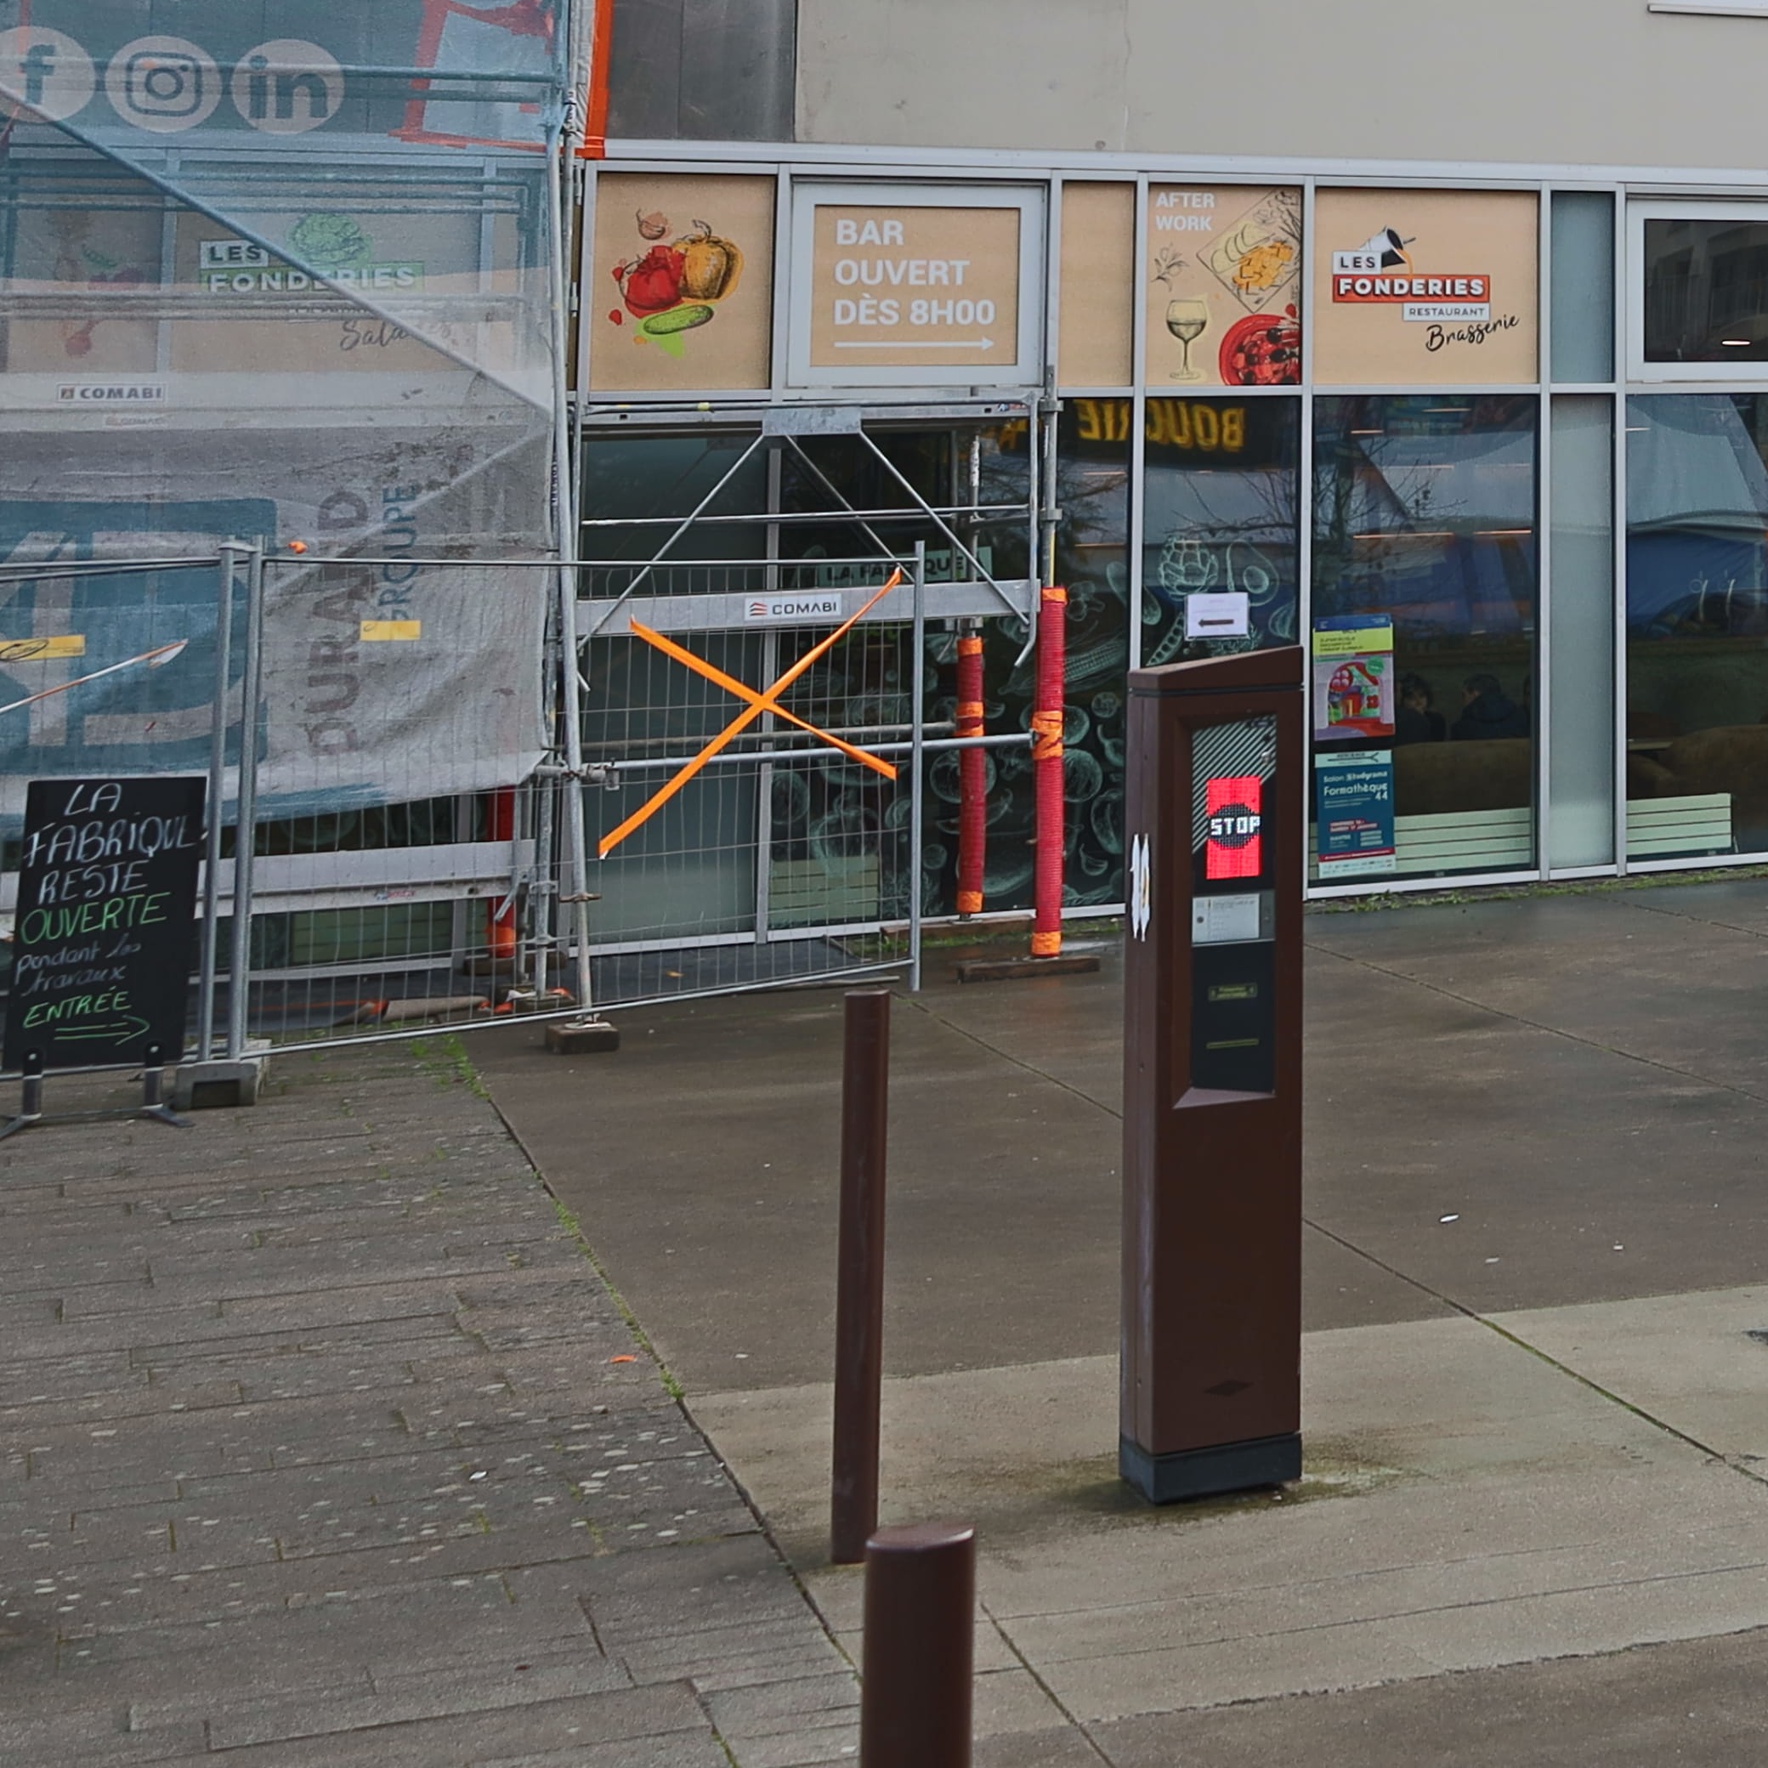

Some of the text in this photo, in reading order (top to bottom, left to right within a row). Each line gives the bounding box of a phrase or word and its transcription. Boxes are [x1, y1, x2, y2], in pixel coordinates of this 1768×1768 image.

[1156, 192, 1215, 208] AFTER
[836, 219, 905, 246] BAR
[1156, 215, 1212, 231] WORK
[209, 244, 262, 263] LES
[1340, 256, 1376, 269] LES
[834, 258, 971, 286] OUVERT
[1338, 278, 1485, 297] FONDERIES
[834, 292, 996, 326] DÈS 8H00
[1408, 308, 1485, 317] RESTAURANT
[1425, 314, 1521, 353] Brasserie
[80, 387, 163, 400] COMABI
[772, 601, 837, 615] COMABI
[64, 782, 122, 816] LA
[1374, 791, 1388, 801] 44
[1211, 815, 1261, 836] STOP
[38, 859, 150, 905] RESTE
[21, 891, 171, 945] OUVERTE
[15, 939, 100, 986] pendant
[20, 965, 127, 998] travaux
[22, 985, 132, 1029] ENTRÉE
